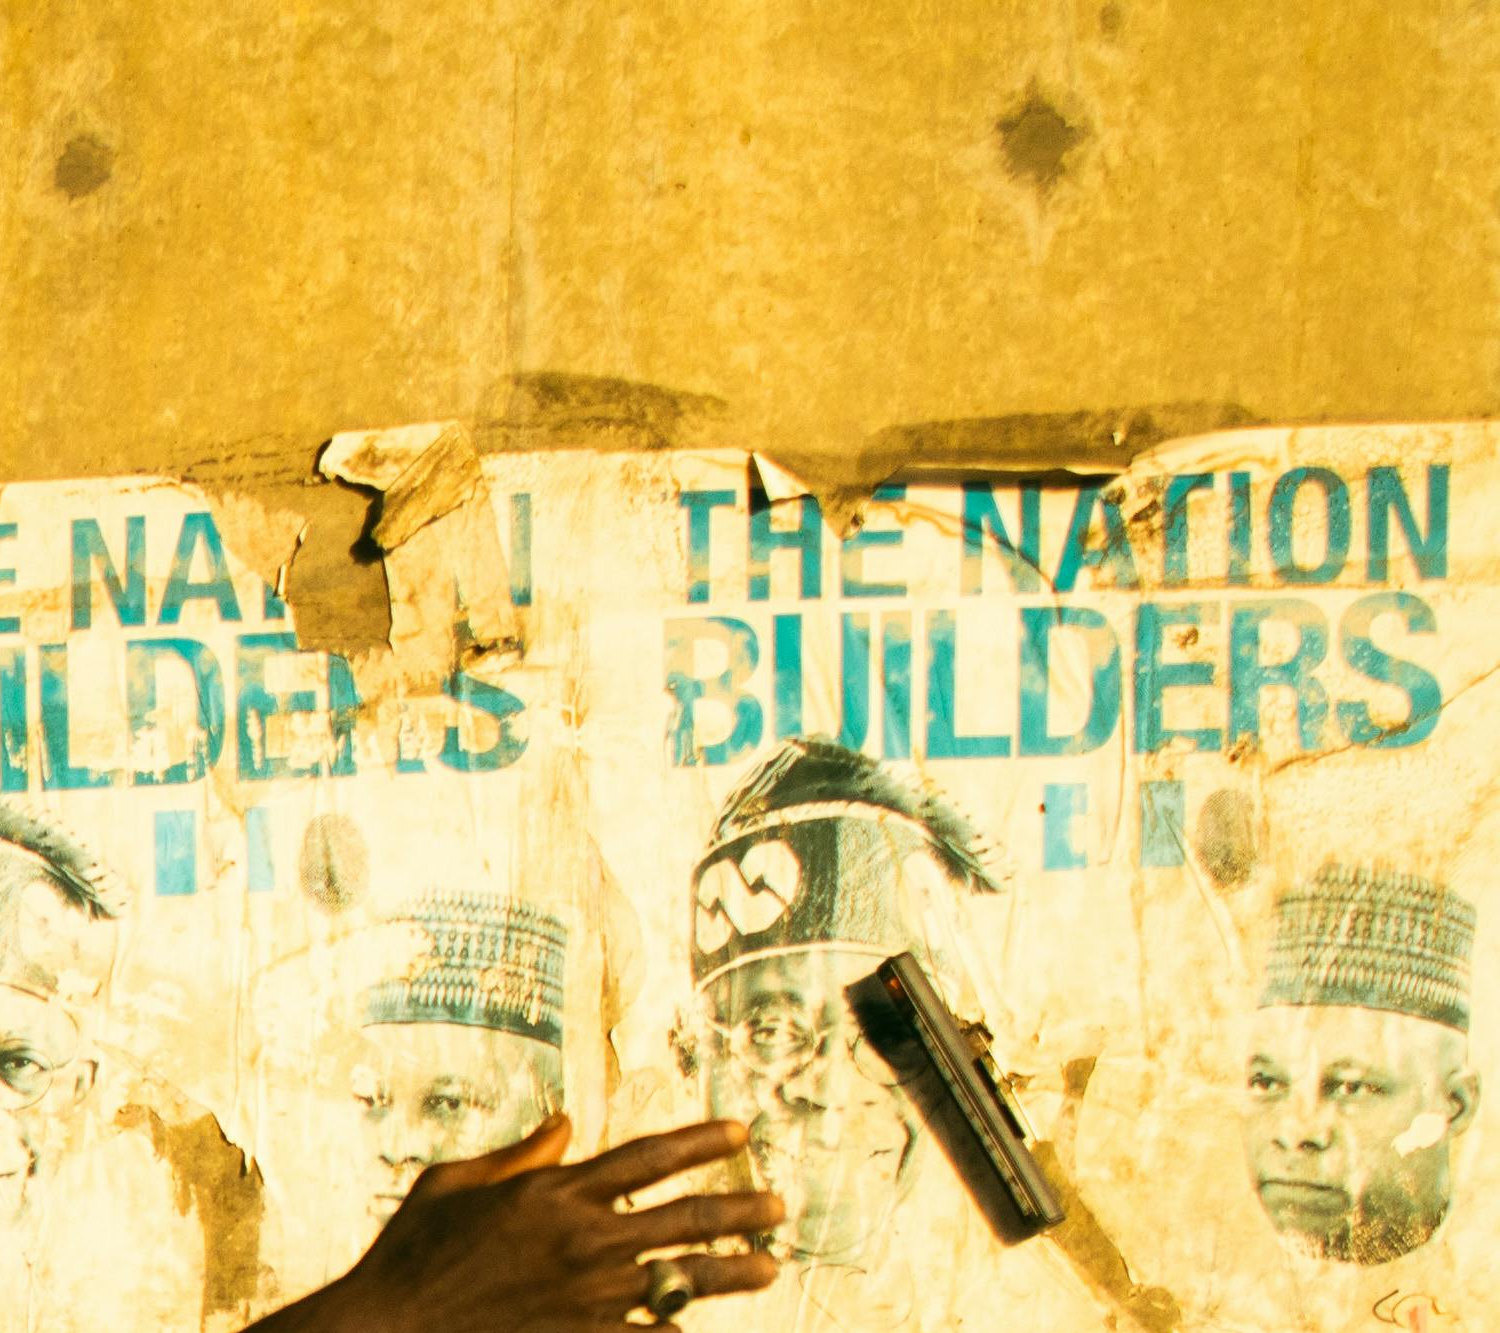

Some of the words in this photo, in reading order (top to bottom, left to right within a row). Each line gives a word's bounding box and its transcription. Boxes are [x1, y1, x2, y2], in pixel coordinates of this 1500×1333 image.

[679, 483, 908, 604] THE
[961, 464, 1451, 594] NATION
[663, 591, 1442, 767] BUILDERS
